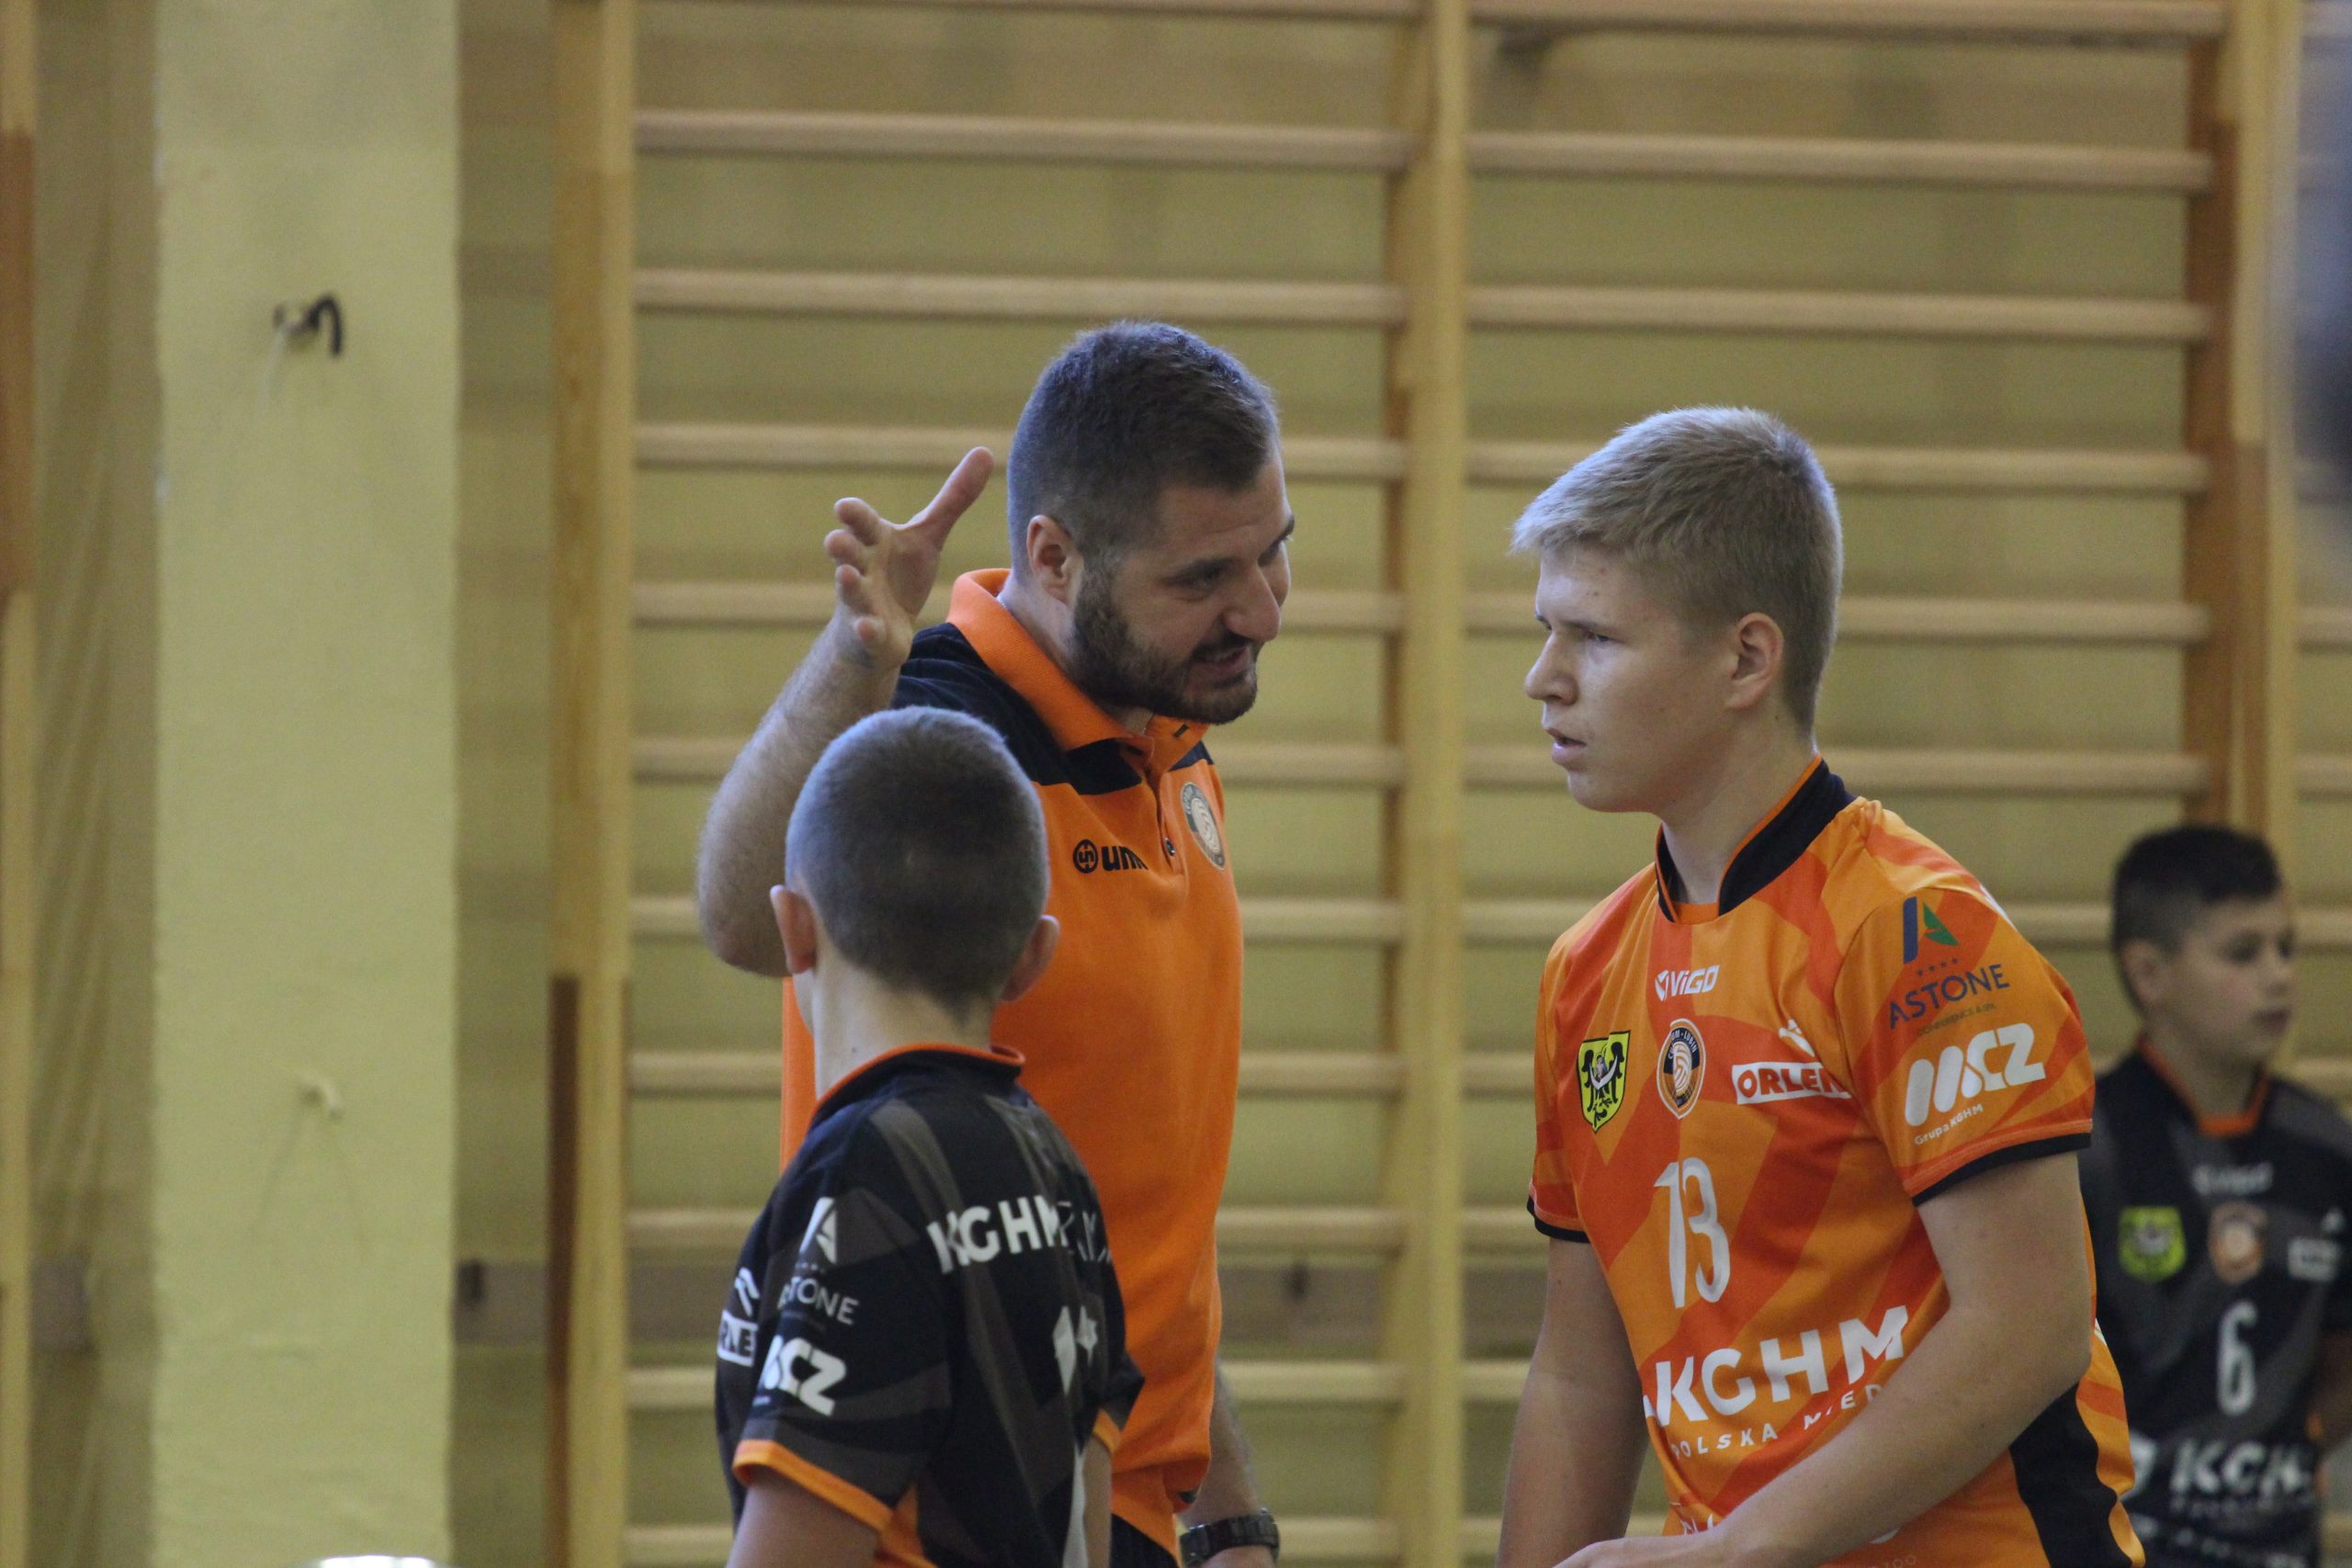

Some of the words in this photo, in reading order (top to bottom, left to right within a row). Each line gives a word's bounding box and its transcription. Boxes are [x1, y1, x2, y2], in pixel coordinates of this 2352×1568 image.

[1890, 964, 2010, 1030] ASTONE
[1905, 1023, 2047, 1127] MCZ
[1915, 1123, 1950, 1145] Grupa
[1950, 1104, 1984, 1127] KGHM
[1654, 1157, 1730, 1308] 13
[777, 1276, 859, 1325] TONE
[1656, 1305, 1908, 1426] KGHM
[2218, 1301, 2257, 1416] 6
[1672, 1423, 1779, 1460] POLSKA
